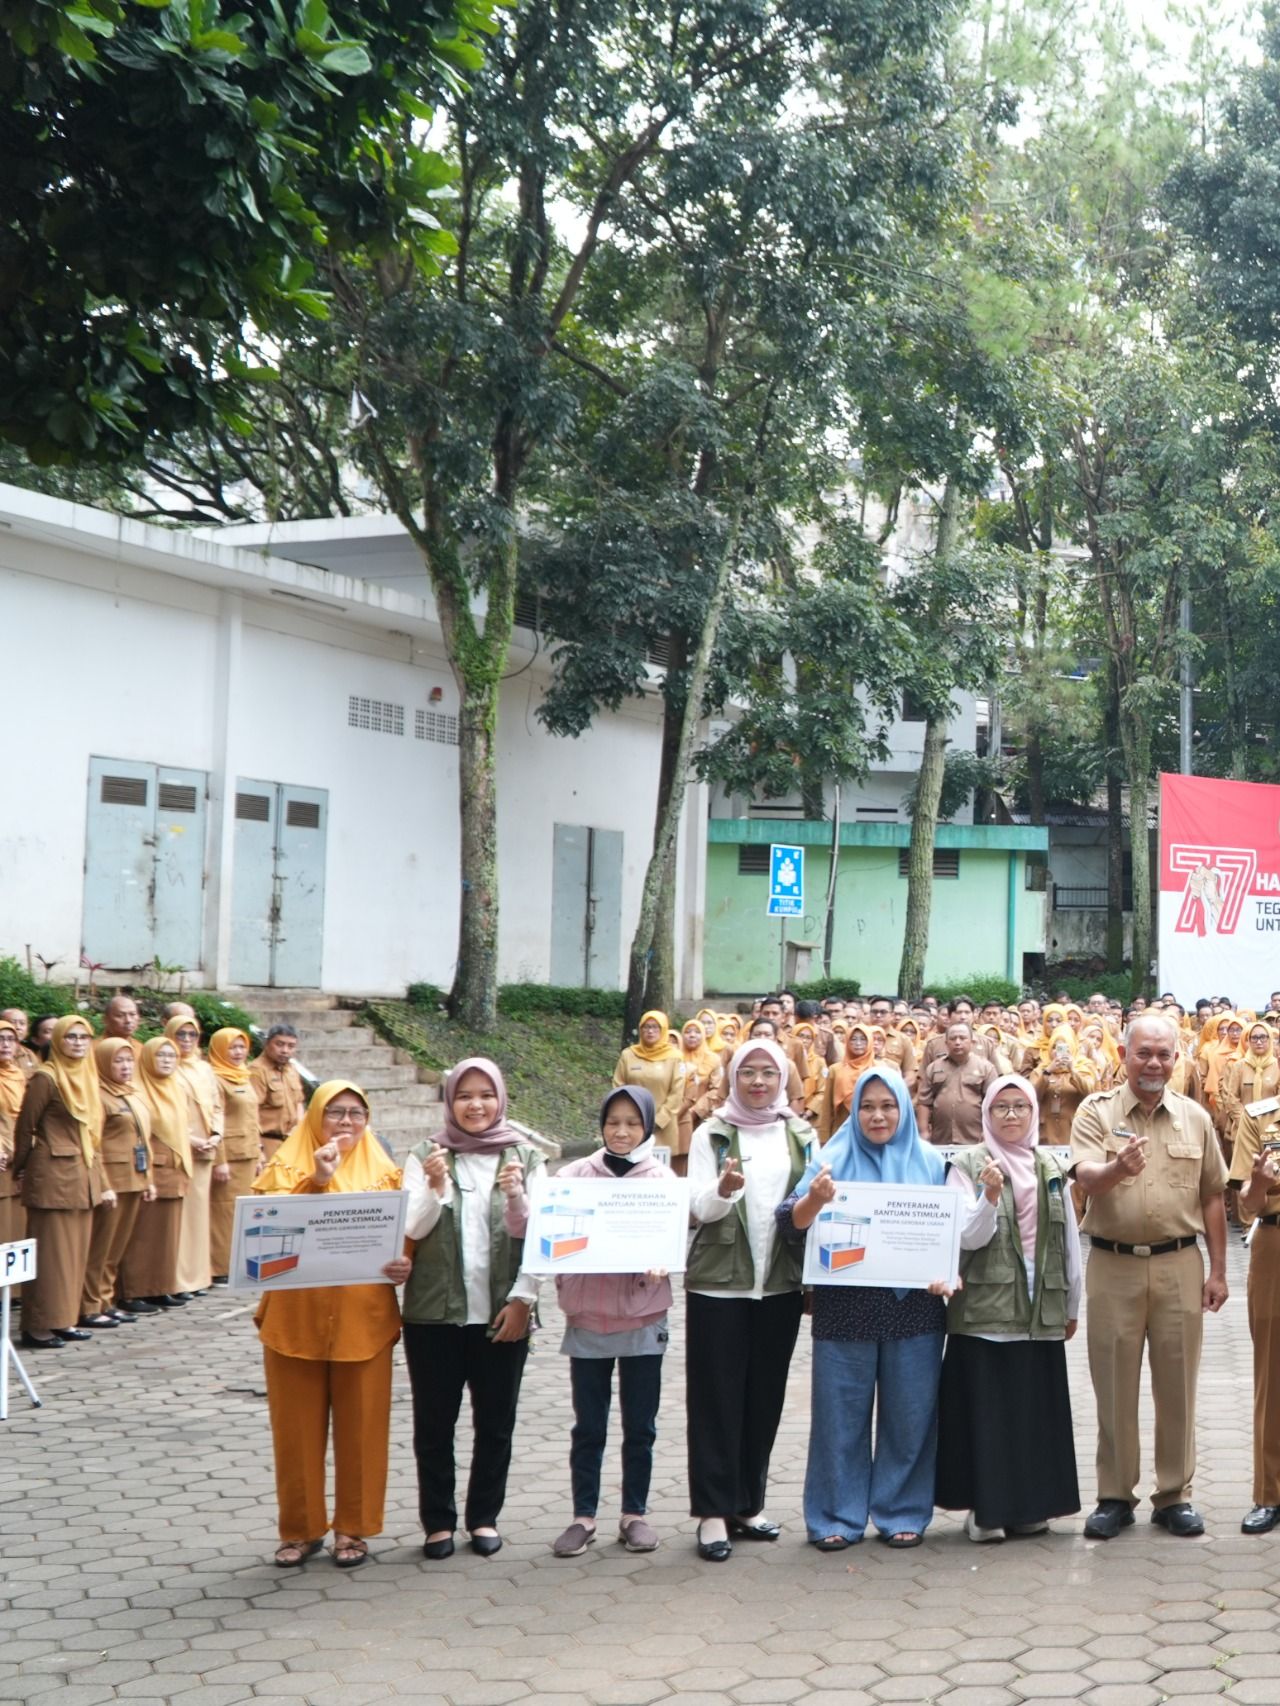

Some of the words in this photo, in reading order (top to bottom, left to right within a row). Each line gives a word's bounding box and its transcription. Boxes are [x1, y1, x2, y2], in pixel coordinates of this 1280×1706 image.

[1169, 843, 1256, 937] 77
[887, 1200, 940, 1210] PENYERAHAN
[323, 1207, 383, 1217] PENYERAHAN
[874, 1209, 910, 1217] BANTUAN
[911, 1211, 951, 1219] STIMULAN
[308, 1217, 349, 1226] BANTUAN
[350, 1215, 395, 1224] STIMULAN
[6, 1248, 29, 1276] PT
